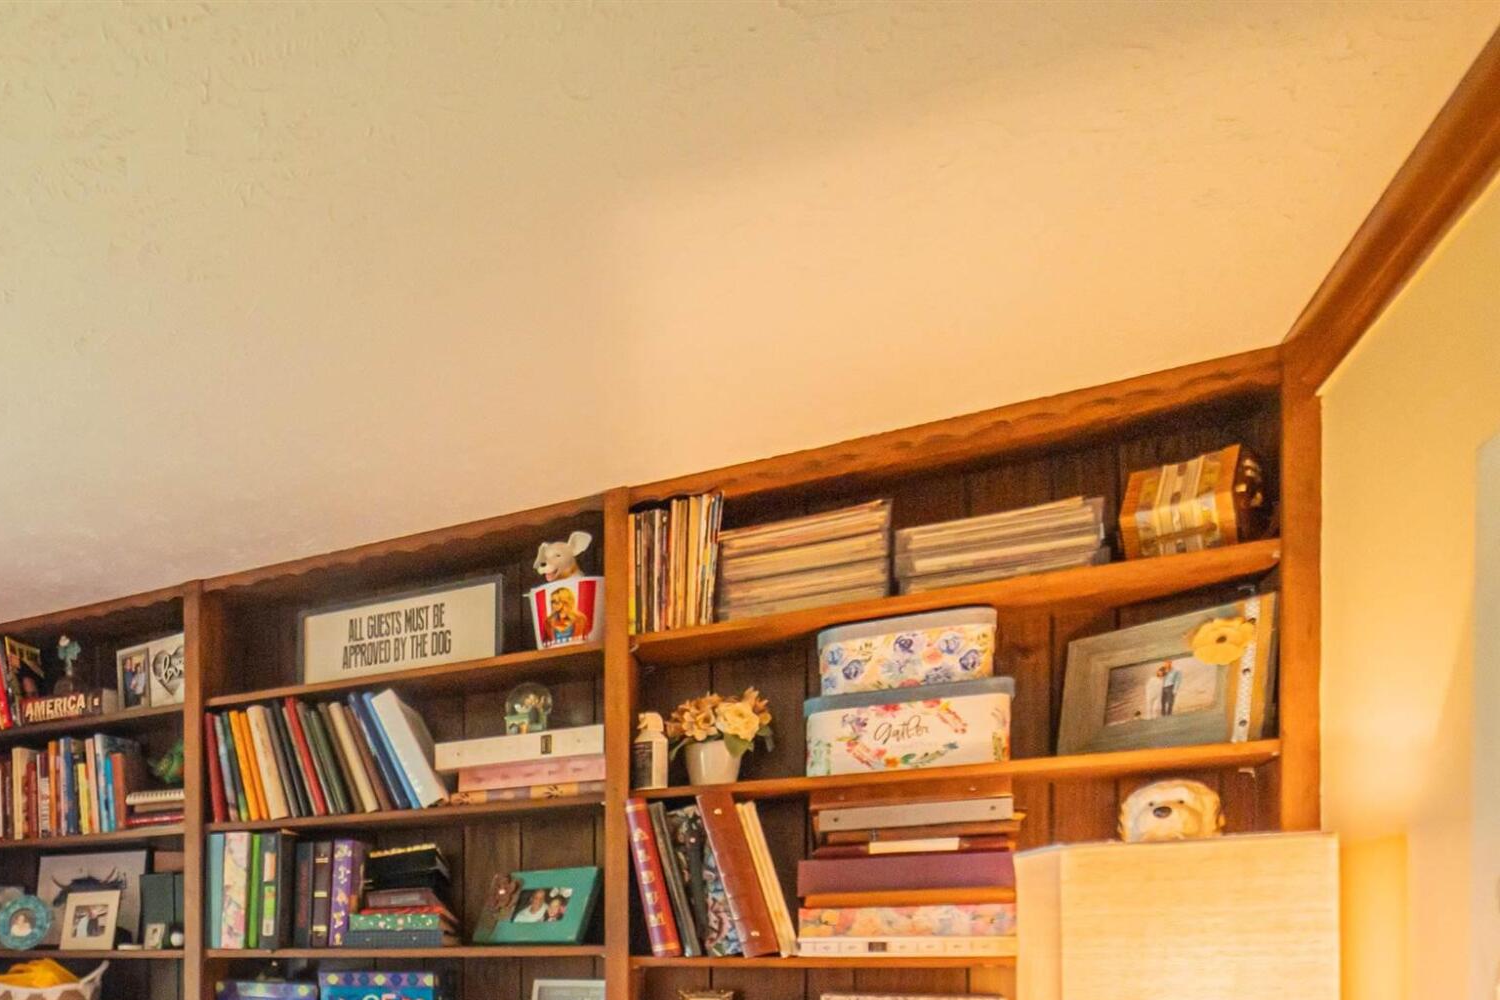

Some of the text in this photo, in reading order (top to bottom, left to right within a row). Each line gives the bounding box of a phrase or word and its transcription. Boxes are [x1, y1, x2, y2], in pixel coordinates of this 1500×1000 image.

[348, 603, 445, 643] ALL GUESTS MUST BE
[342, 629, 452, 669] APPROVED BY THE DOG
[25, 693, 86, 721] AMERICA
[632, 827, 666, 928] ALBUM
